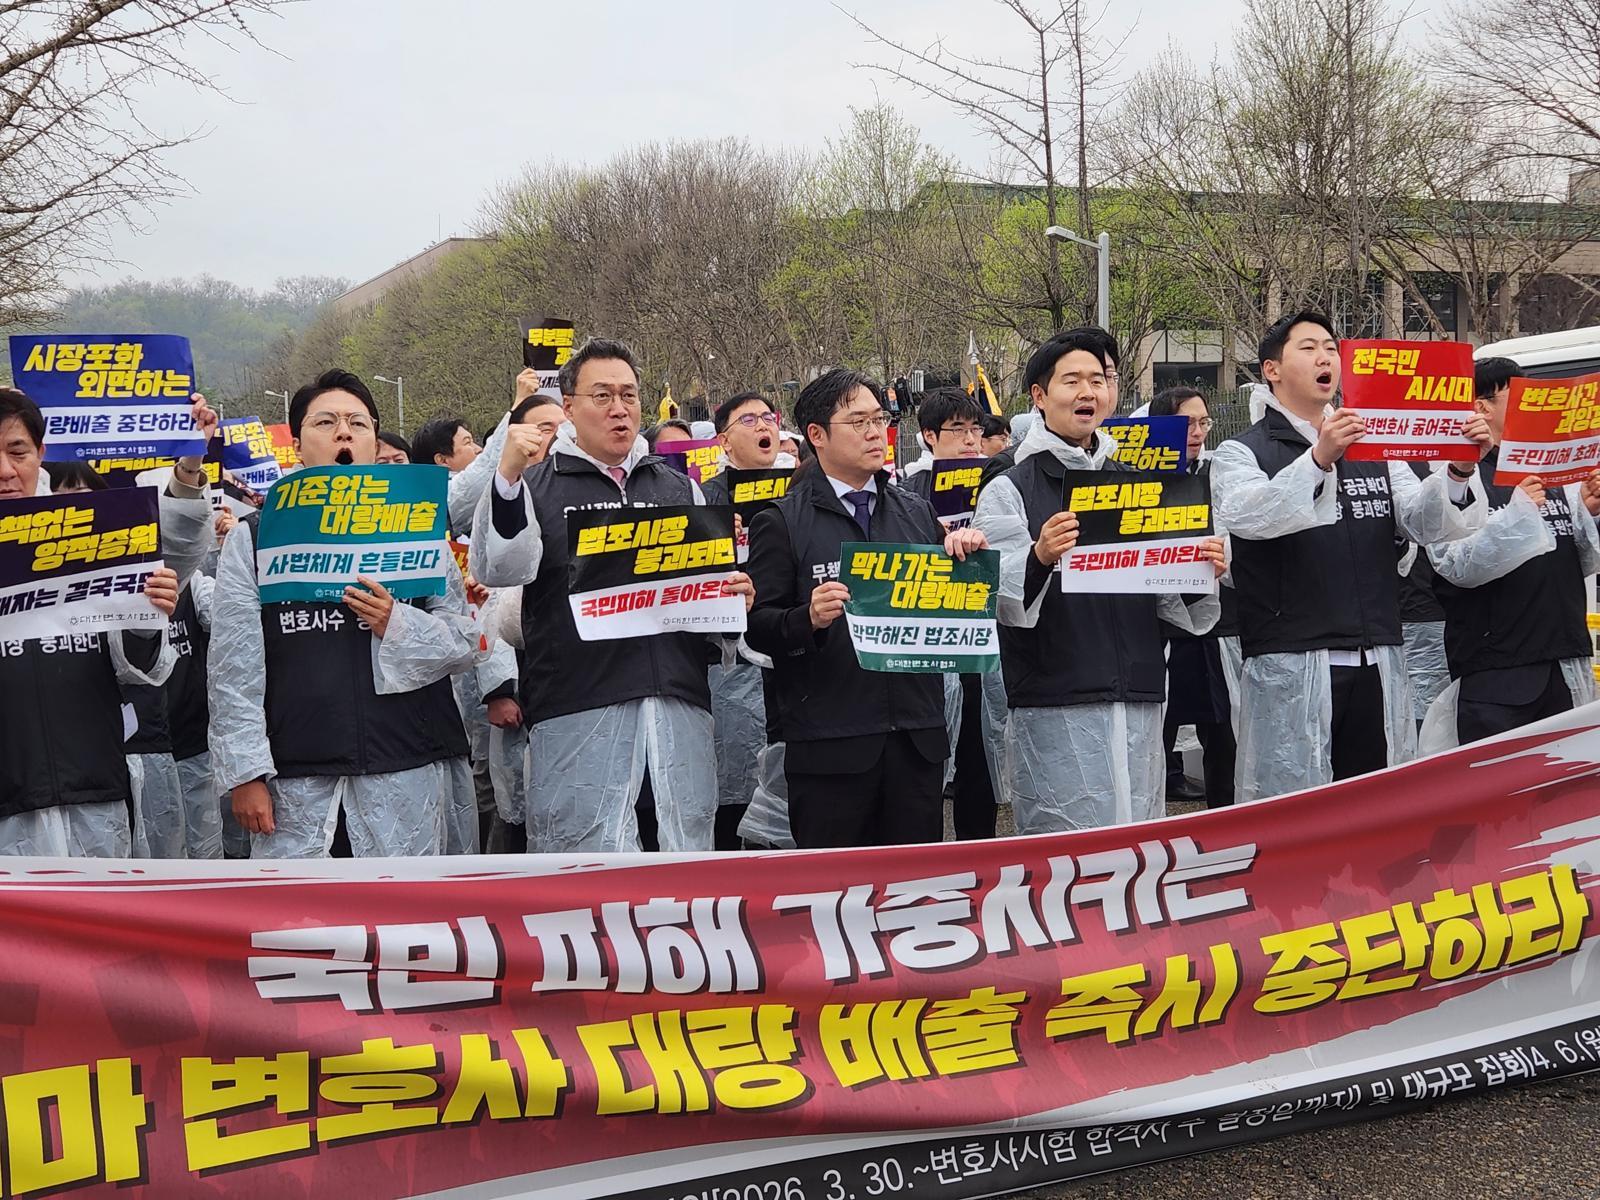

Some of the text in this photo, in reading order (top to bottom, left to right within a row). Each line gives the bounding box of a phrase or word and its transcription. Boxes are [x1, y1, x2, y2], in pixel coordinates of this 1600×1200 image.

[24, 343, 143, 372] 시장포화
[1352, 348, 1420, 376] 전국민
[75, 369, 190, 399] 외면하는
[1404, 376, 1473, 403] AI시대
[1518, 382, 1598, 412] 변호사간
[44, 415, 111, 435] 량배출
[1098, 424, 1150, 448] 포화
[1362, 417, 1468, 436] 년변호사 굶어죽는
[1112, 446, 1181, 470] 면하는
[1506, 446, 1573, 466] 국민피해
[276, 475, 389, 511] 기준없는
[1069, 482, 1163, 512] 법조시장
[1343, 476, 1389, 496] 공급확대
[319, 502, 439, 535] 대량배출
[1119, 505, 1209, 535] 붕괴되면
[32, 523, 157, 572] 양적증원
[576, 515, 689, 556] 법조시장
[266, 552, 354, 577] 사법체계
[358, 549, 440, 574] 흔들린다
[633, 537, 735, 575] 붕괴되면
[851, 552, 953, 582] 막나가는
[1069, 550, 1140, 572] 국민피해
[581, 589, 657, 618] 국민피해
[890, 581, 991, 611] 대량배출
[279, 608, 345, 634] 변호사수
[852, 624, 992, 646] 막막해진 법조시장
[248, 836, 1257, 1011] 국민 피해 가중시키는
[181, 1027, 567, 1172] 변호사
[576, 1004, 807, 1116] 대량
[819, 987, 1027, 1089] 배출
[1046, 942, 1239, 1046] 즉시
[1253, 864, 1589, 1013] 중단하라
[1400, 1058, 1477, 1100] 대규모
